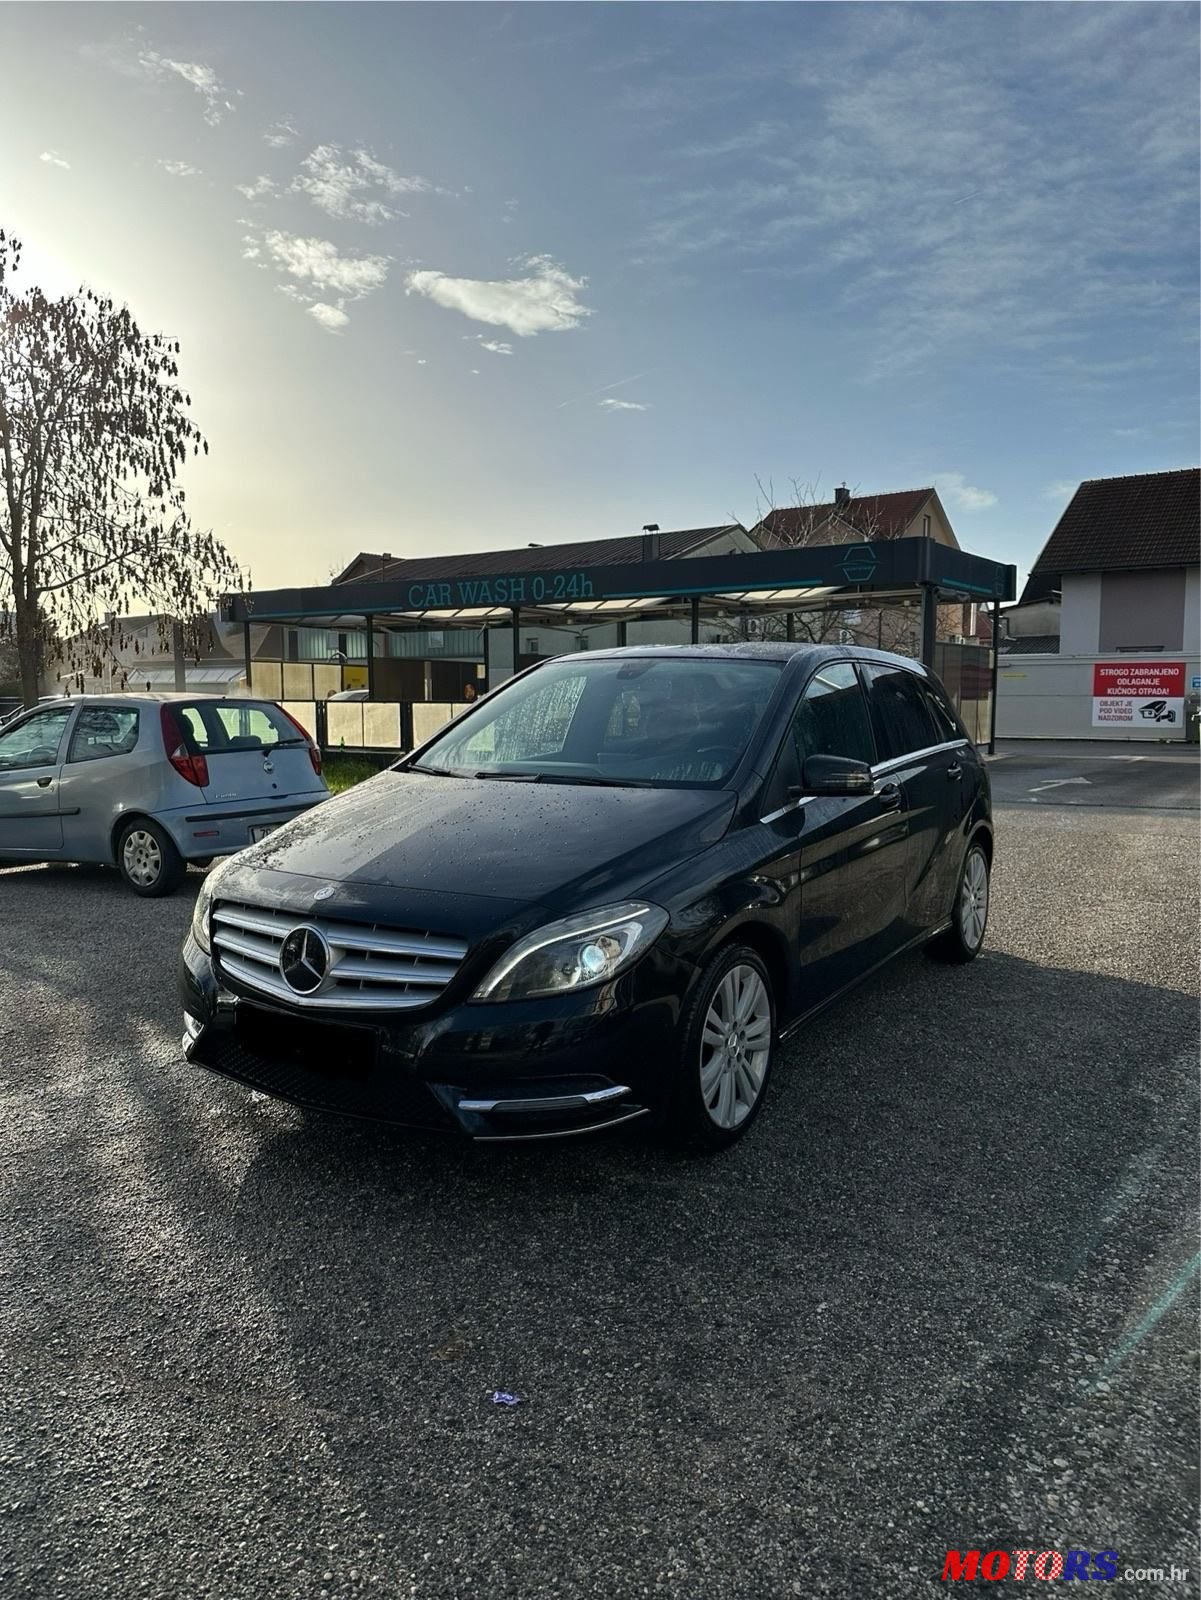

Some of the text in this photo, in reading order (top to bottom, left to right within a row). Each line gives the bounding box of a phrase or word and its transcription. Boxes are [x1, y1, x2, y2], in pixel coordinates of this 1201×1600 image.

[408, 573, 594, 607] CAR WASH 0-24h
[1099, 668, 1179, 676] STROGO ZABRANJENO
[1117, 678, 1160, 686] ODLAGANJE
[1138, 687, 1170, 695] OTPADA!
